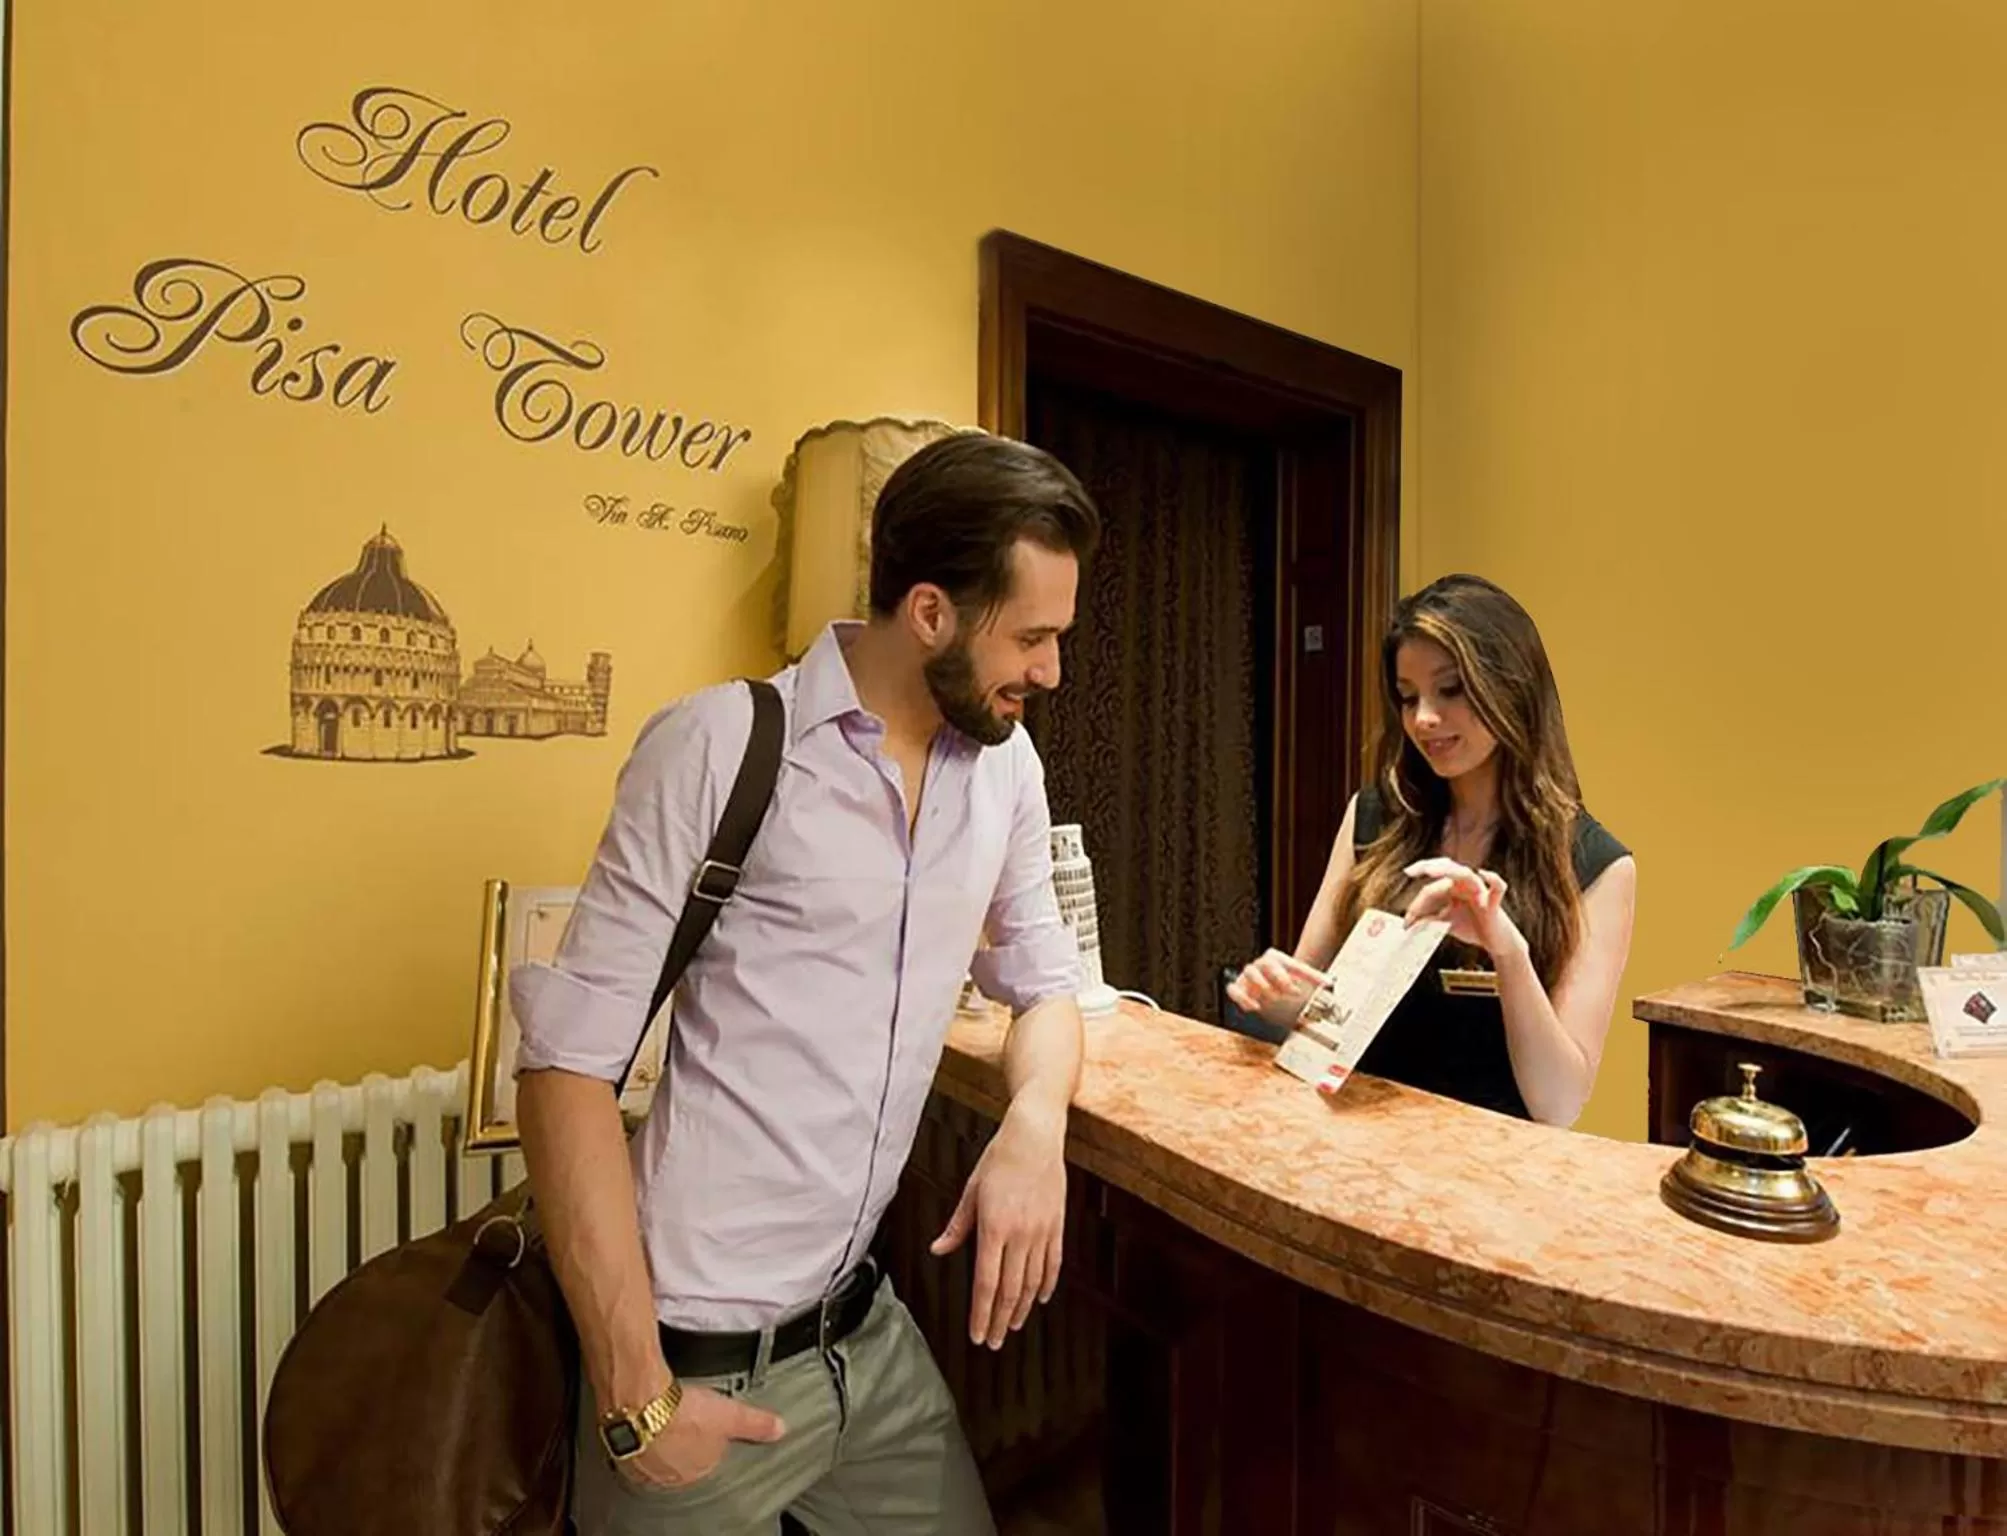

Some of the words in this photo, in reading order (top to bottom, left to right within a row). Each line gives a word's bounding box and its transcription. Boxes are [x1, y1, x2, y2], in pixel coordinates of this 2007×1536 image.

[296, 87, 660, 253] Hotel
[70, 258, 397, 413] Pisa
[460, 312, 752, 470] Tower
